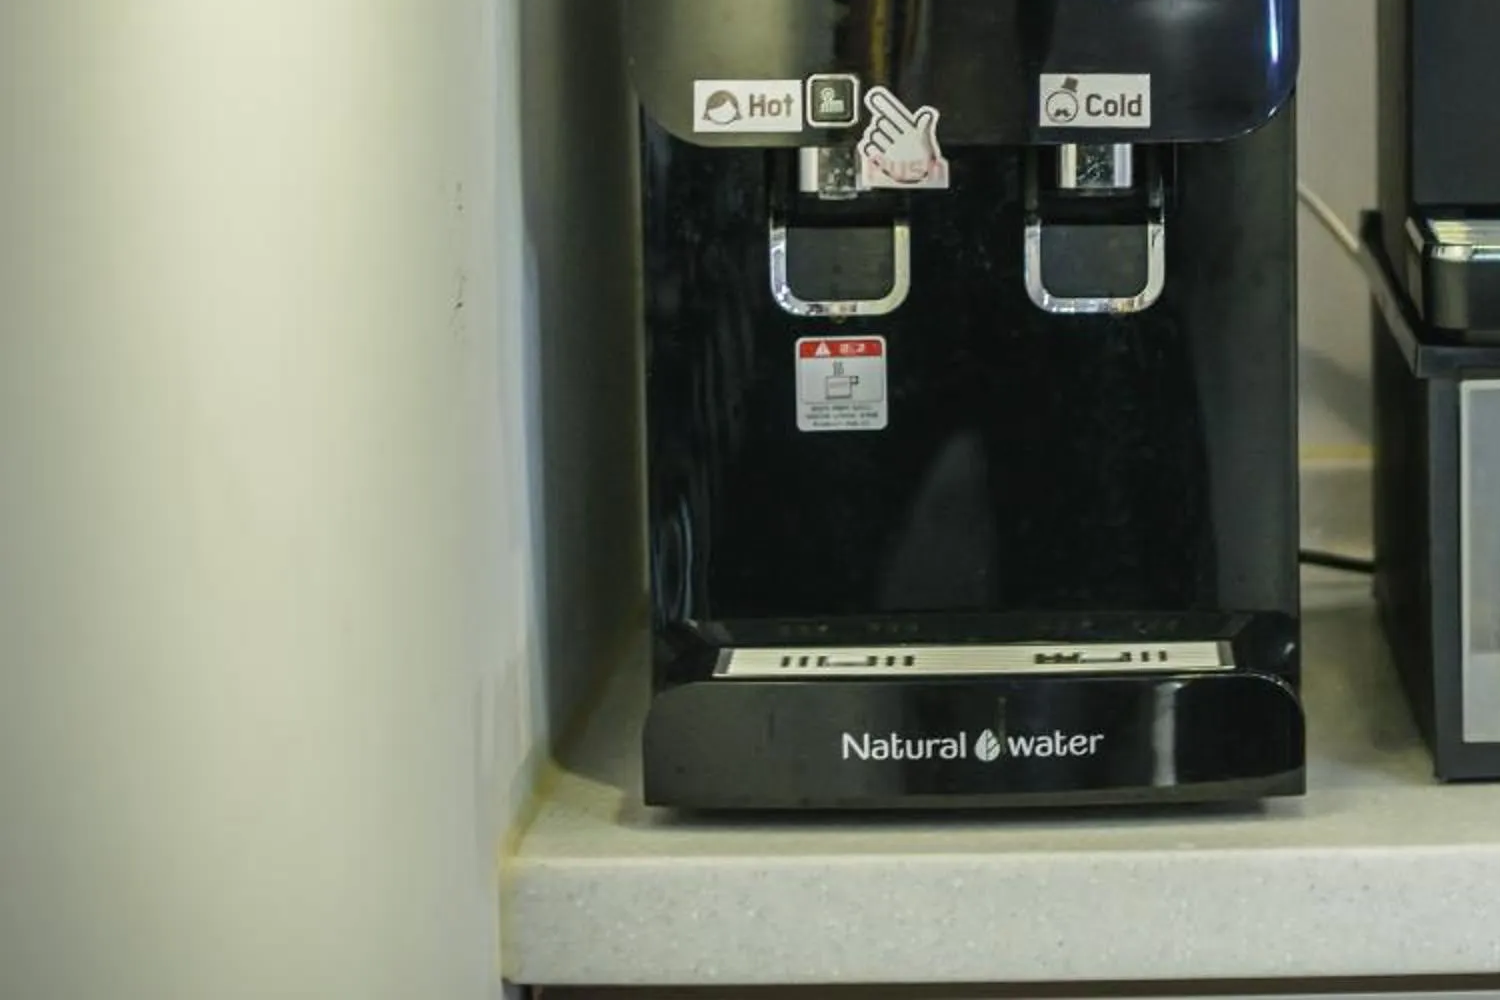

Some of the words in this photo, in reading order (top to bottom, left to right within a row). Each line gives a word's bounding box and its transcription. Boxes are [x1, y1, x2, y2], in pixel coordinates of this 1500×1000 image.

[748, 93, 794, 118] Hot
[1085, 93, 1143, 117] Cold
[841, 731, 967, 761] Natural
[1007, 730, 1106, 759] water
